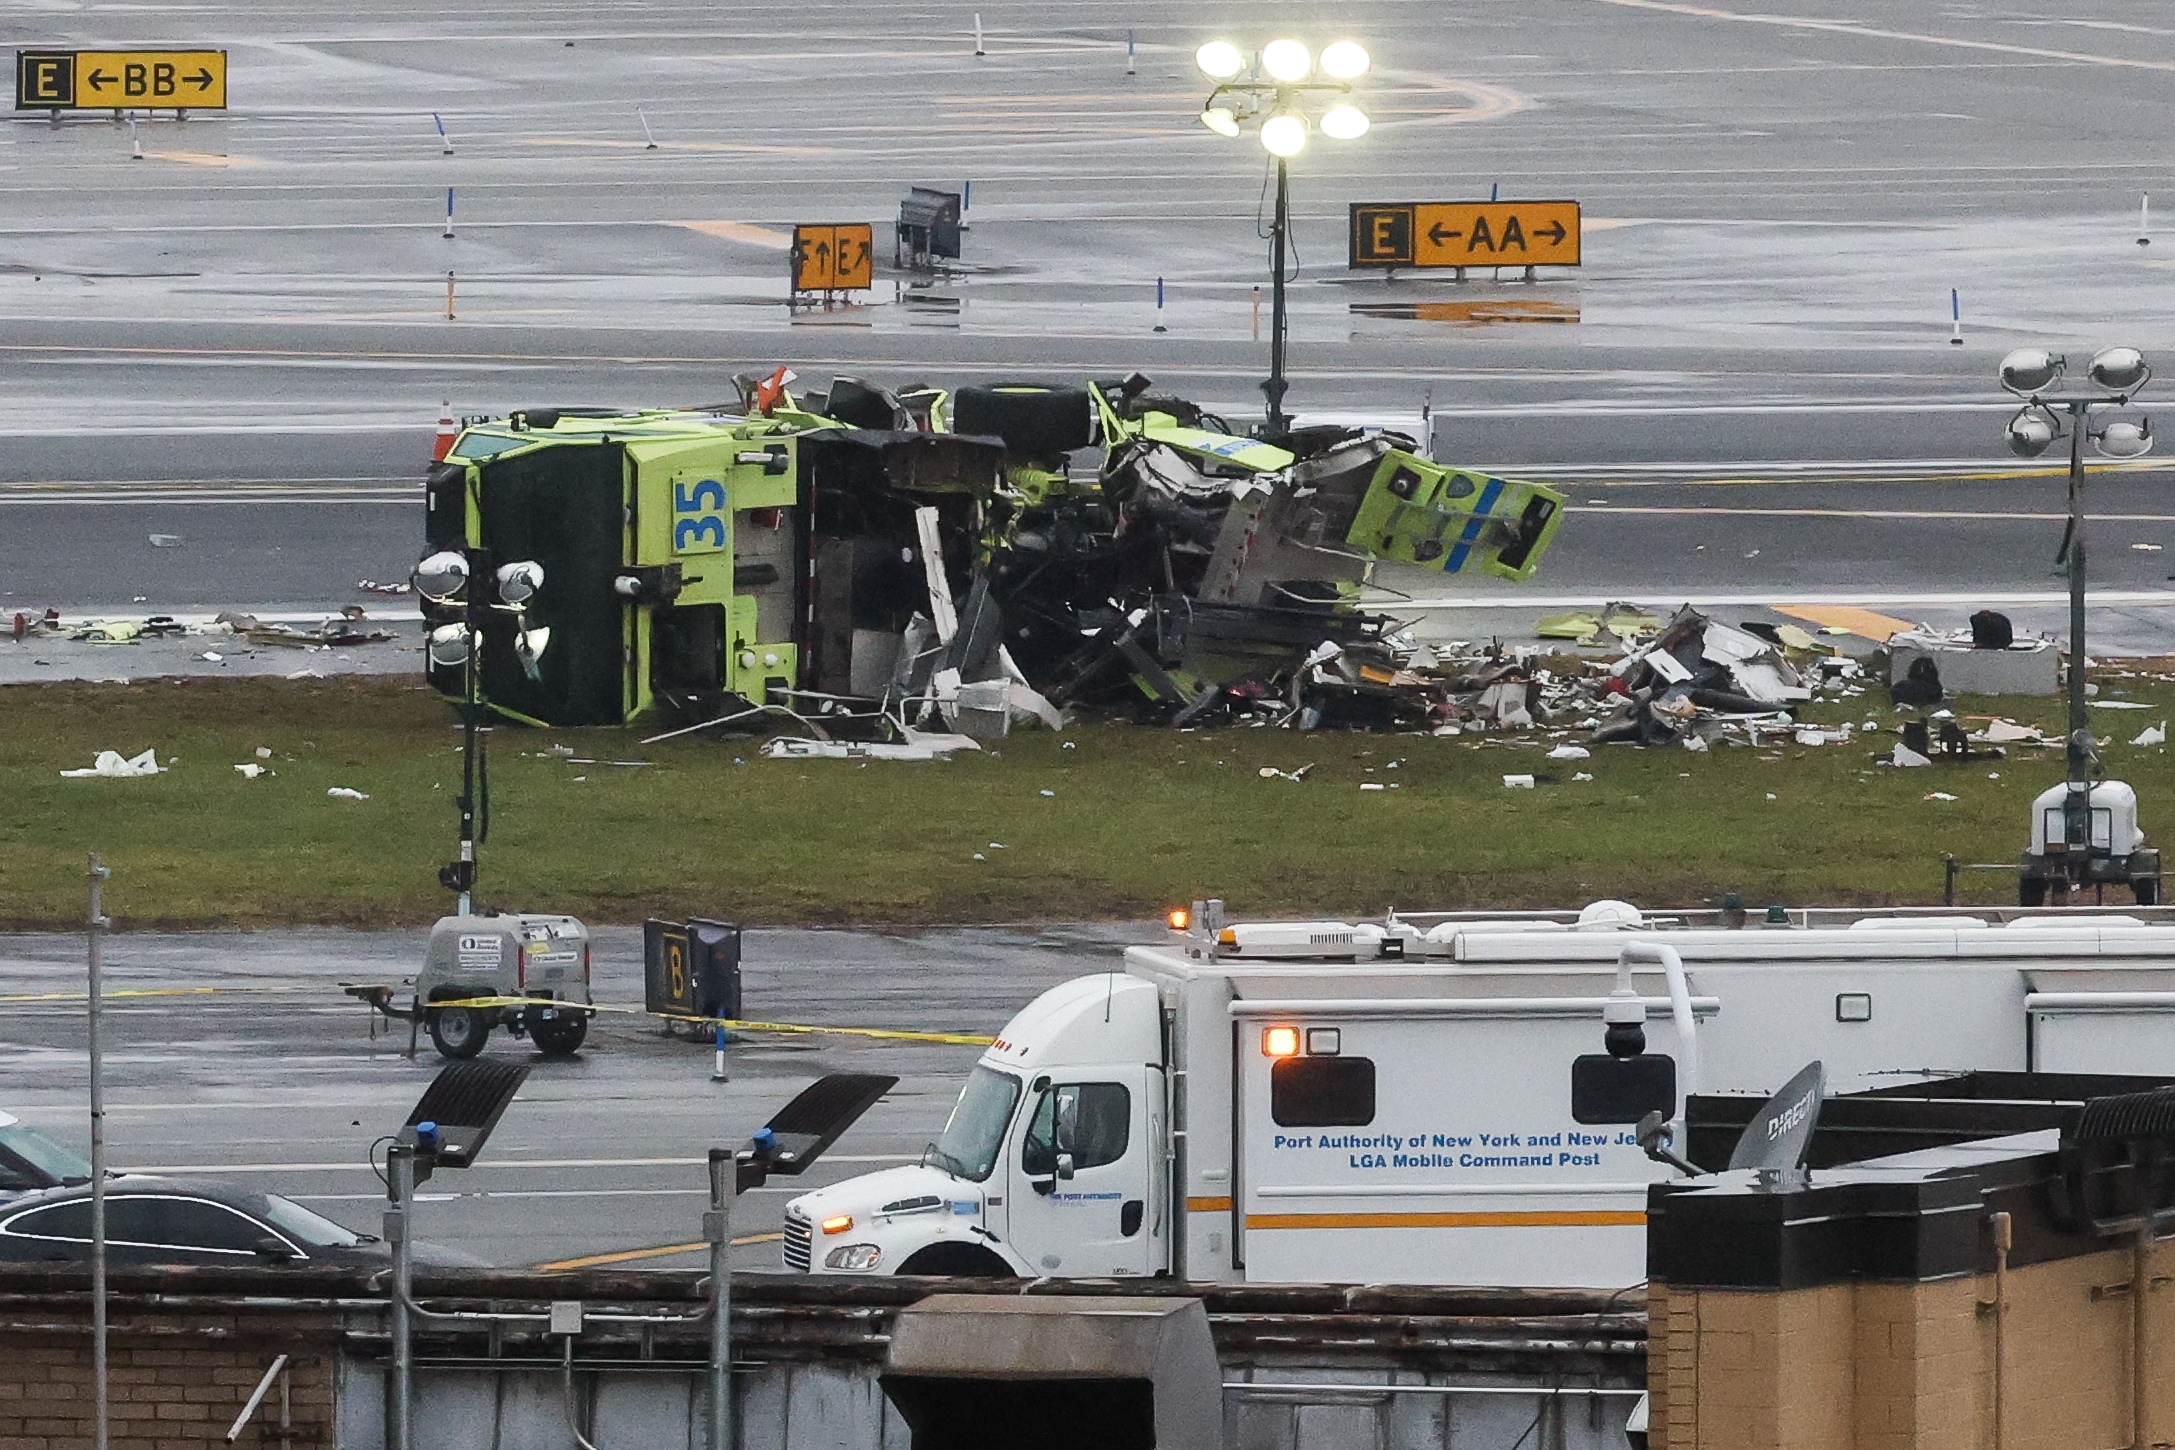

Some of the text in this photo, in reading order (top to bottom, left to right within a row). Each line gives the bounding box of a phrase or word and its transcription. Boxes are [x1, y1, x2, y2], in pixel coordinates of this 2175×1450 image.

[37, 63, 176, 97] E BB
[1372, 215, 1528, 254] E AA
[839, 238, 851, 275] E
[675, 480, 726, 549] 35
[1274, 1135, 1312, 1149] Port
[1319, 1133, 1402, 1150] Authority
[1408, 1134, 1426, 1148] of
[1432, 1134, 1472, 1148] New
[1479, 1133, 1521, 1147] York
[1527, 1132, 1561, 1147] and
[1567, 1132, 1607, 1146] New
[1349, 1152, 1601, 1168] LGA Mobile Command Post
